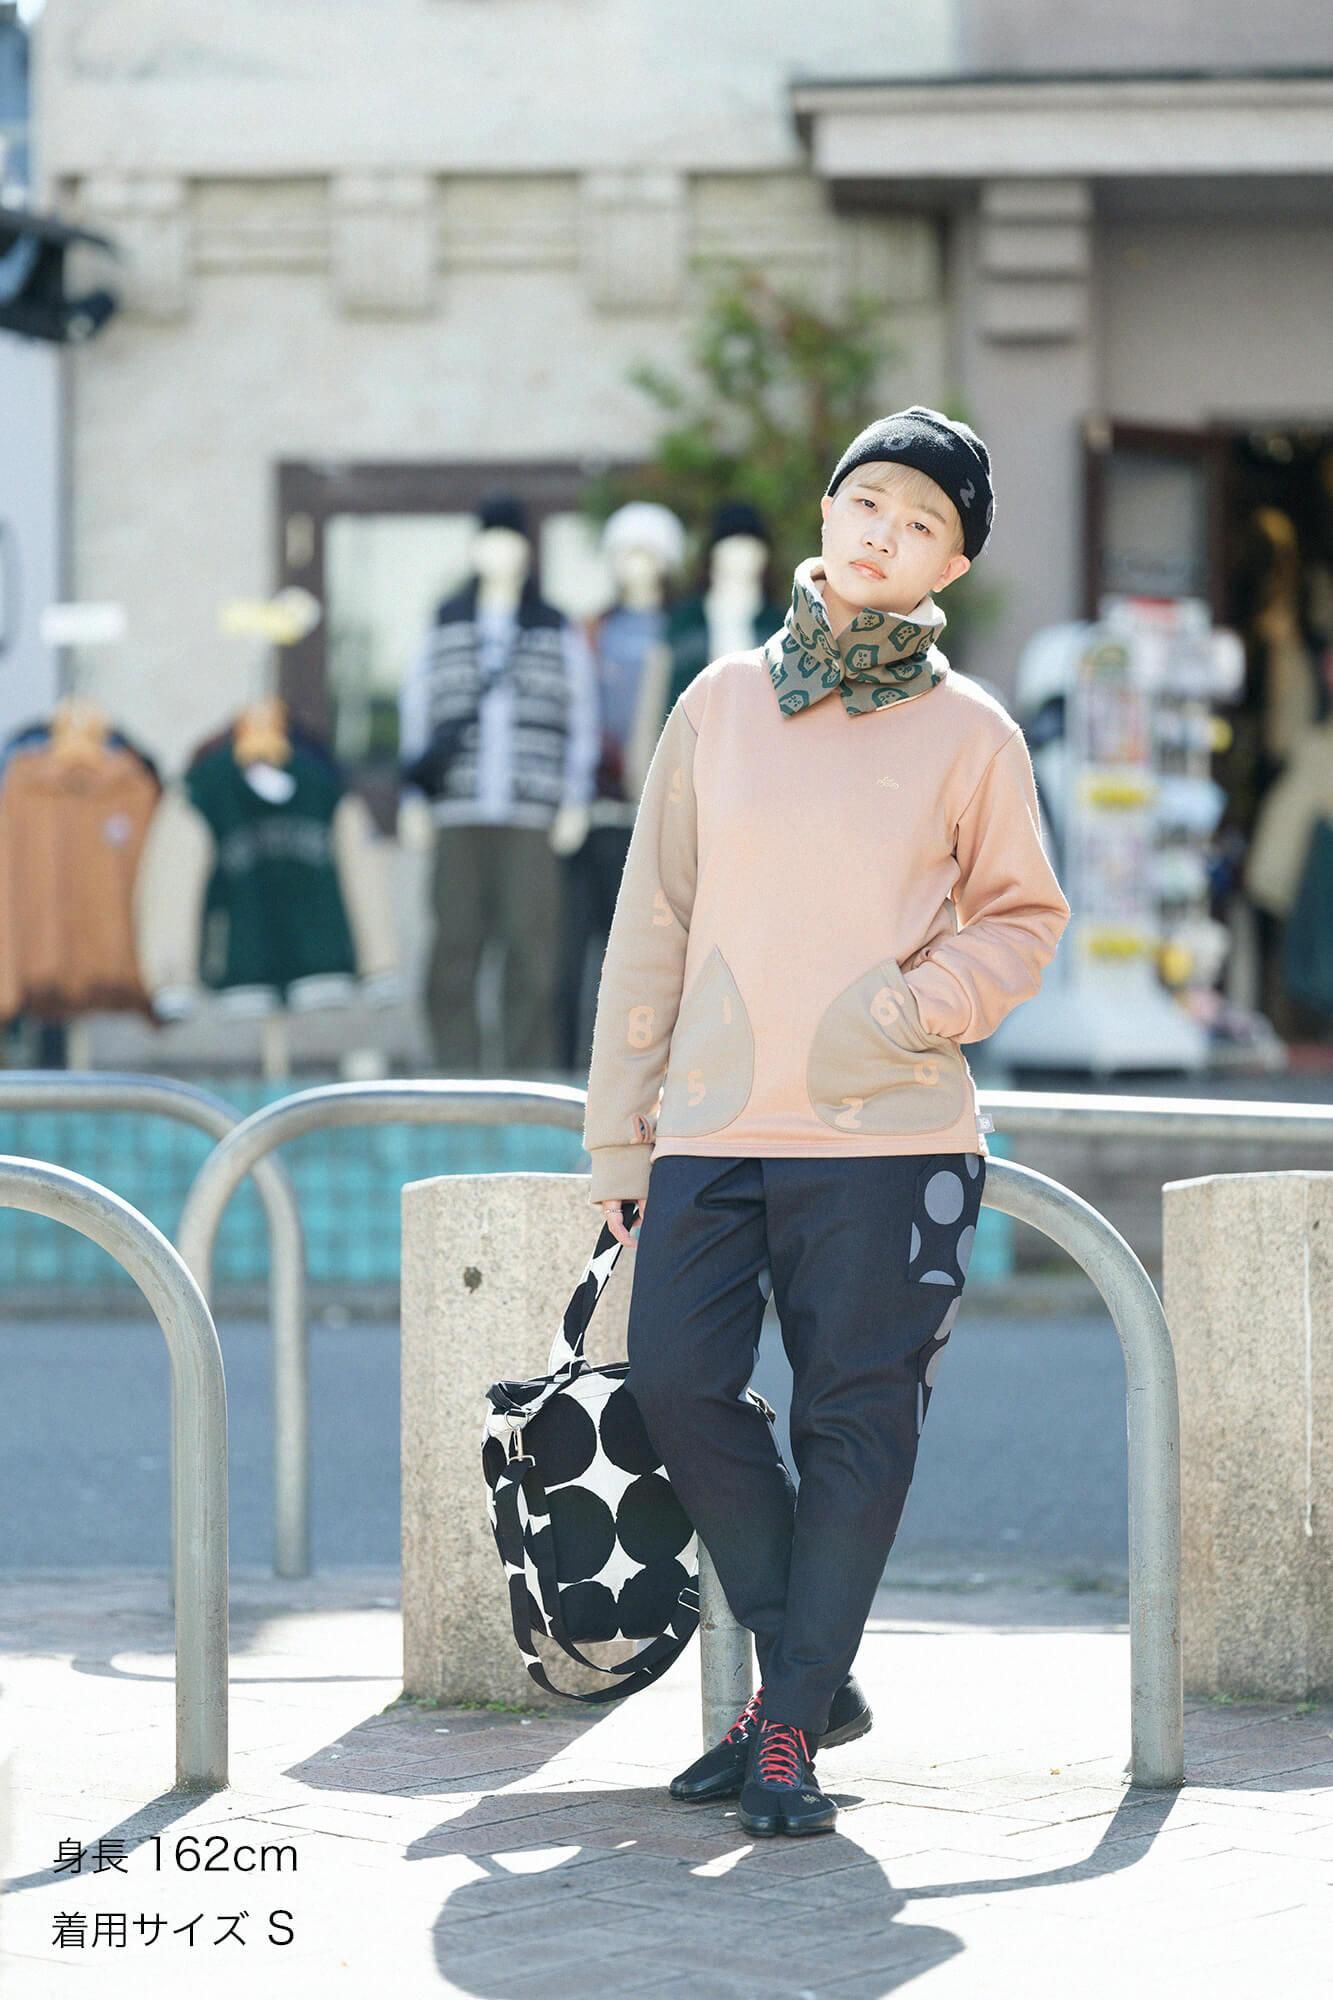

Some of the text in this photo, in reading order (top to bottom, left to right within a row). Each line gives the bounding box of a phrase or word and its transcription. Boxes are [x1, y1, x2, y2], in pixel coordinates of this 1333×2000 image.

[869, 986, 905, 1026] 6
[627, 1005, 656, 1049] 8
[687, 1069, 707, 1107] 5
